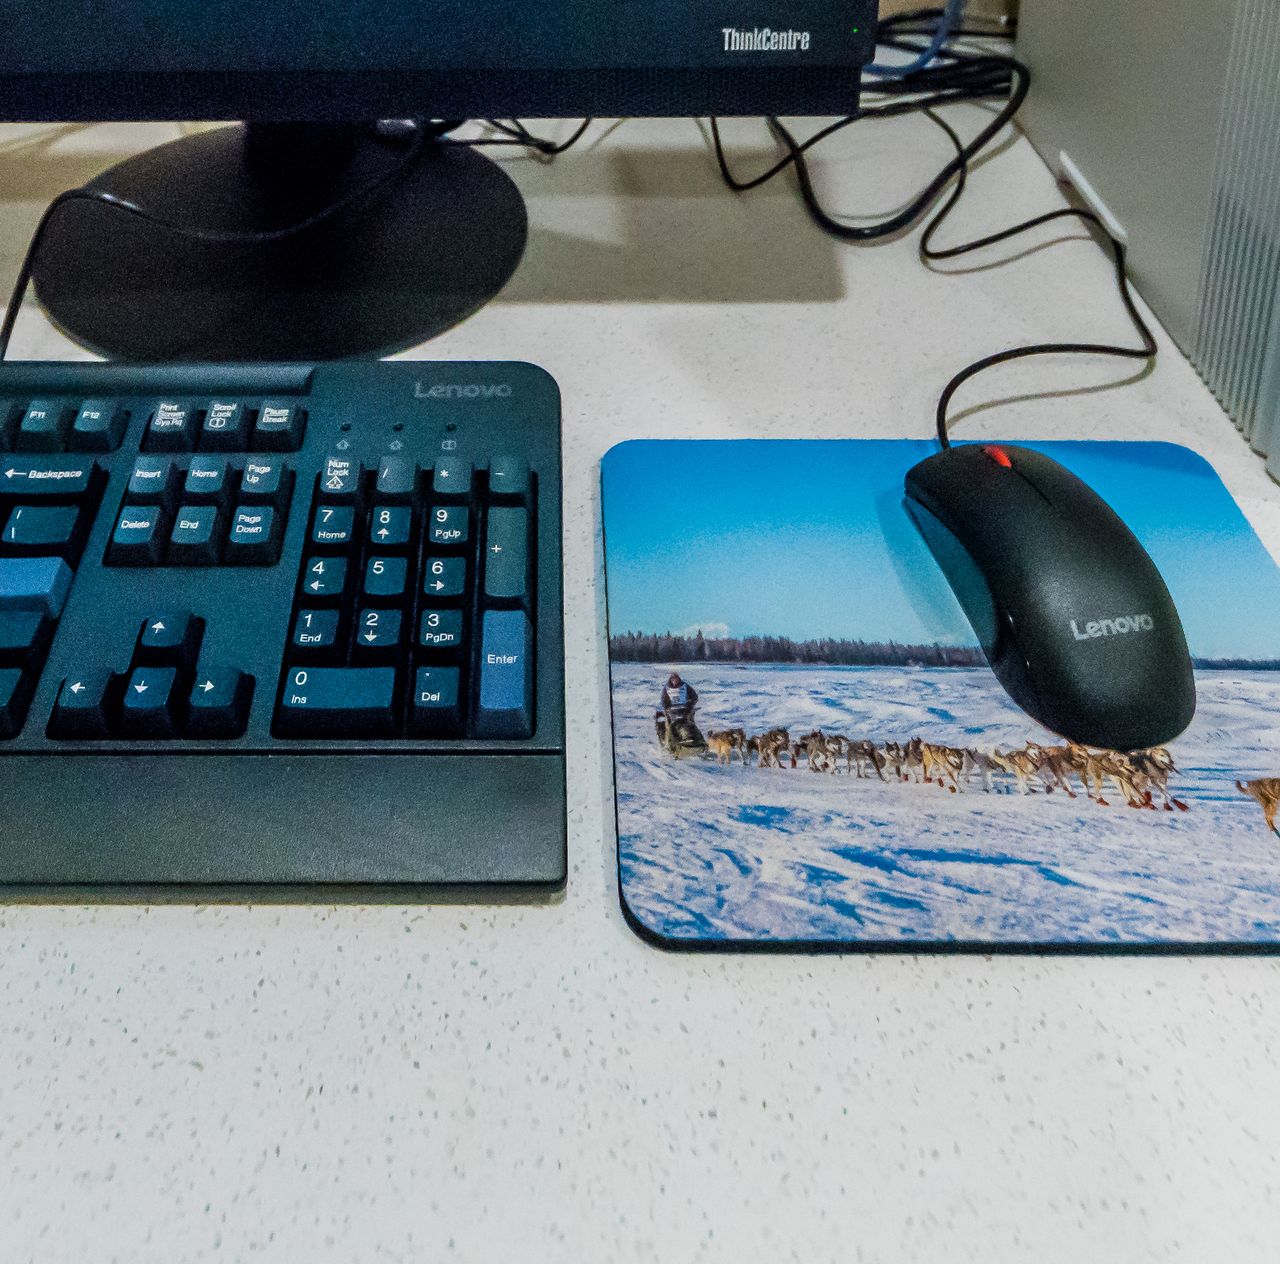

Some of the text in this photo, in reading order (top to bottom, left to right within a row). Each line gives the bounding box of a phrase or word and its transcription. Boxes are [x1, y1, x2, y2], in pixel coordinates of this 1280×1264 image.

[722, 27, 810, 51] ThinkCentre
[414, 381, 512, 398] Lenovo
[160, 403, 178, 411] Print
[213, 403, 237, 411] Scroll
[29, 410, 46, 419] F11
[81, 410, 101, 420] F12
[211, 410, 231, 418] Lock
[248, 464, 271, 475] Page
[328, 460, 349, 468] Num
[28, 469, 83, 480] Backspace
[134, 468, 162, 479] Insert
[191, 469, 219, 478] Home
[327, 468, 349, 476] Lock
[246, 475, 259, 484] Up
[238, 514, 262, 524] Page
[321, 509, 334, 523] 7
[379, 510, 391, 524] 8
[436, 509, 449, 523] 9
[120, 519, 151, 529] Delete
[179, 520, 200, 530] End
[236, 525, 262, 533] Down
[317, 531, 347, 539] Home
[435, 529, 462, 540] PgUp
[490, 544, 502, 553] +
[311, 560, 325, 575] 4
[372, 560, 385, 575] 5
[431, 560, 444, 575] 6
[304, 613, 313, 628] 1
[365, 612, 379, 627] 2
[427, 613, 440, 627] 3
[1070, 614, 1154, 641] Lenovo
[299, 633, 322, 643] End
[425, 632, 454, 643] PgDn
[487, 653, 518, 665] Enter
[294, 670, 308, 686] 0
[290, 694, 307, 705] Ins
[421, 691, 441, 702] Del
